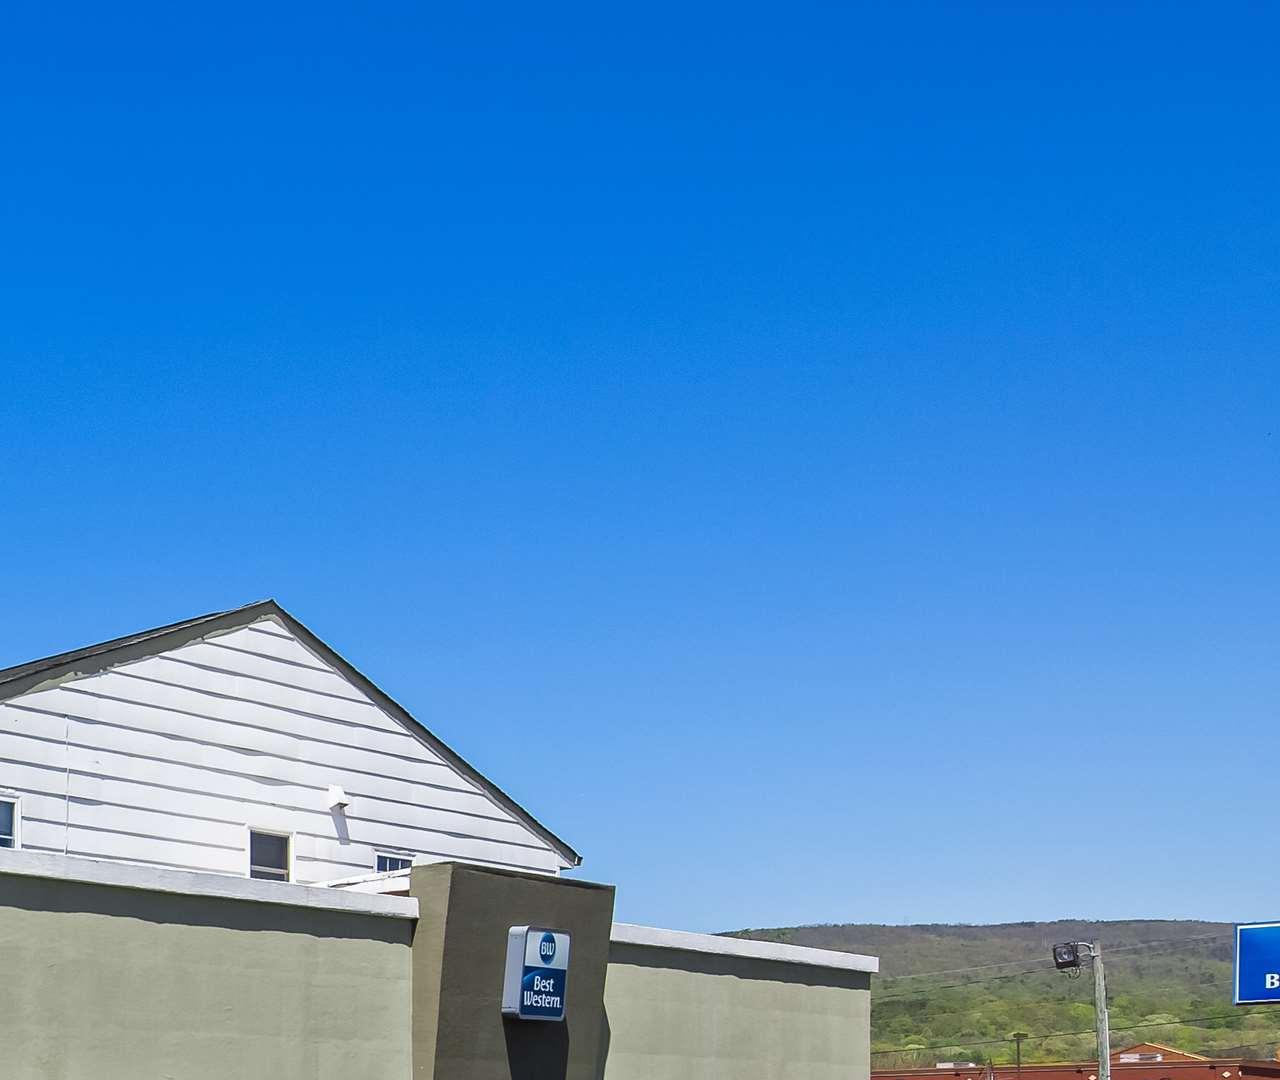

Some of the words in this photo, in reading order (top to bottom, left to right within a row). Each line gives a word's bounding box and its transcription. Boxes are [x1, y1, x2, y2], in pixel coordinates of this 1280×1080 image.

[541, 942, 555, 955] BW
[534, 976, 554, 992] Best
[523, 990, 560, 1008] Western
